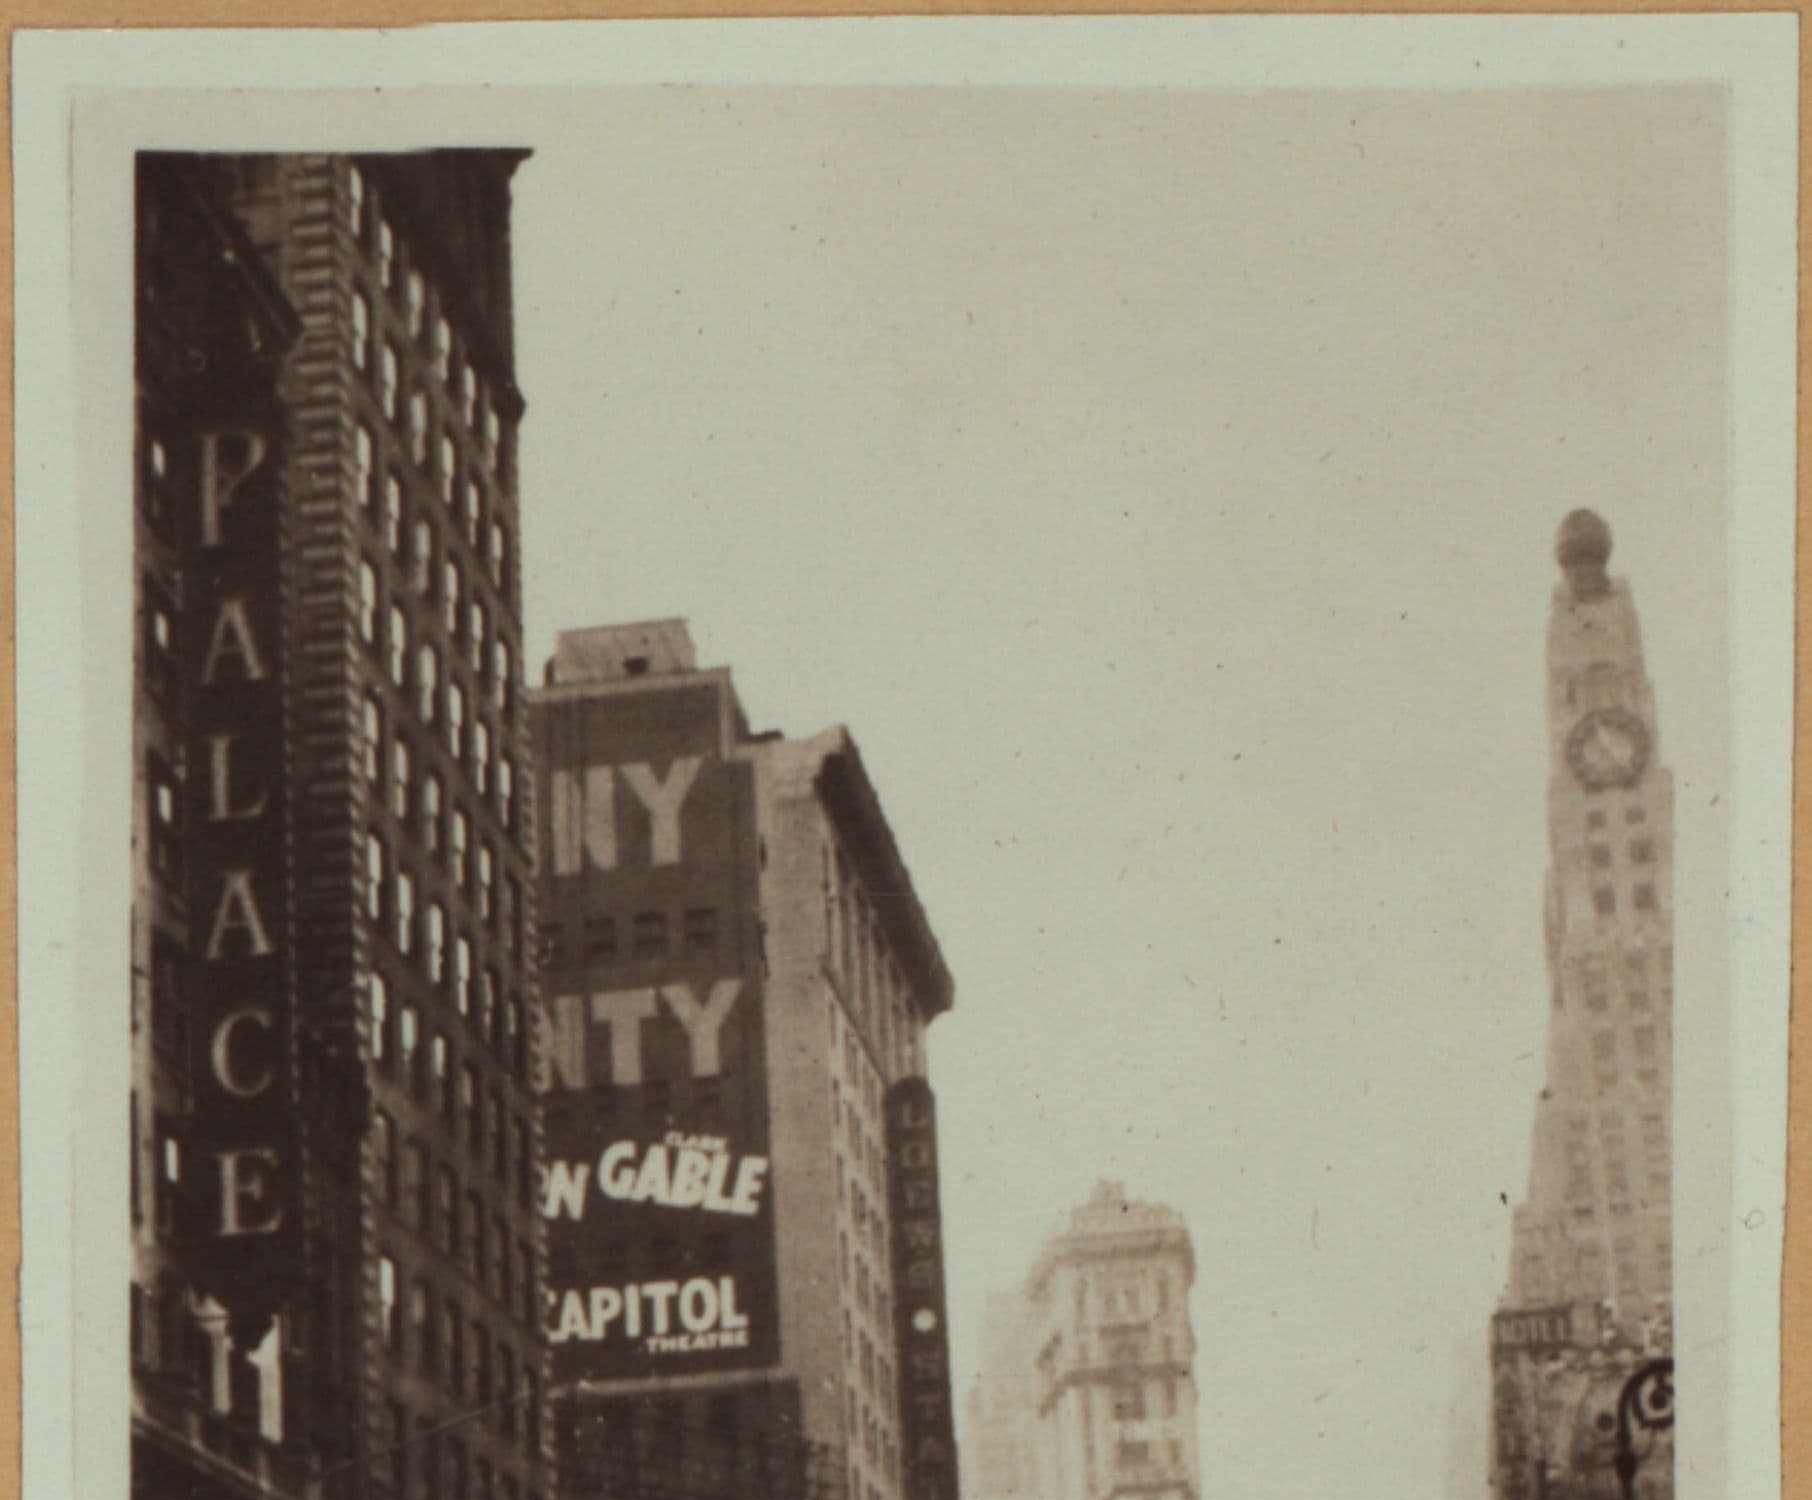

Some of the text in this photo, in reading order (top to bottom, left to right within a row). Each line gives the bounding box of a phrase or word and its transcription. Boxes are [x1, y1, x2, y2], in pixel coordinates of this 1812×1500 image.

[201, 430, 283, 1237] PALACE
[597, 1139, 769, 1217] GABLE
[645, 1330, 749, 1354] THEATRE
